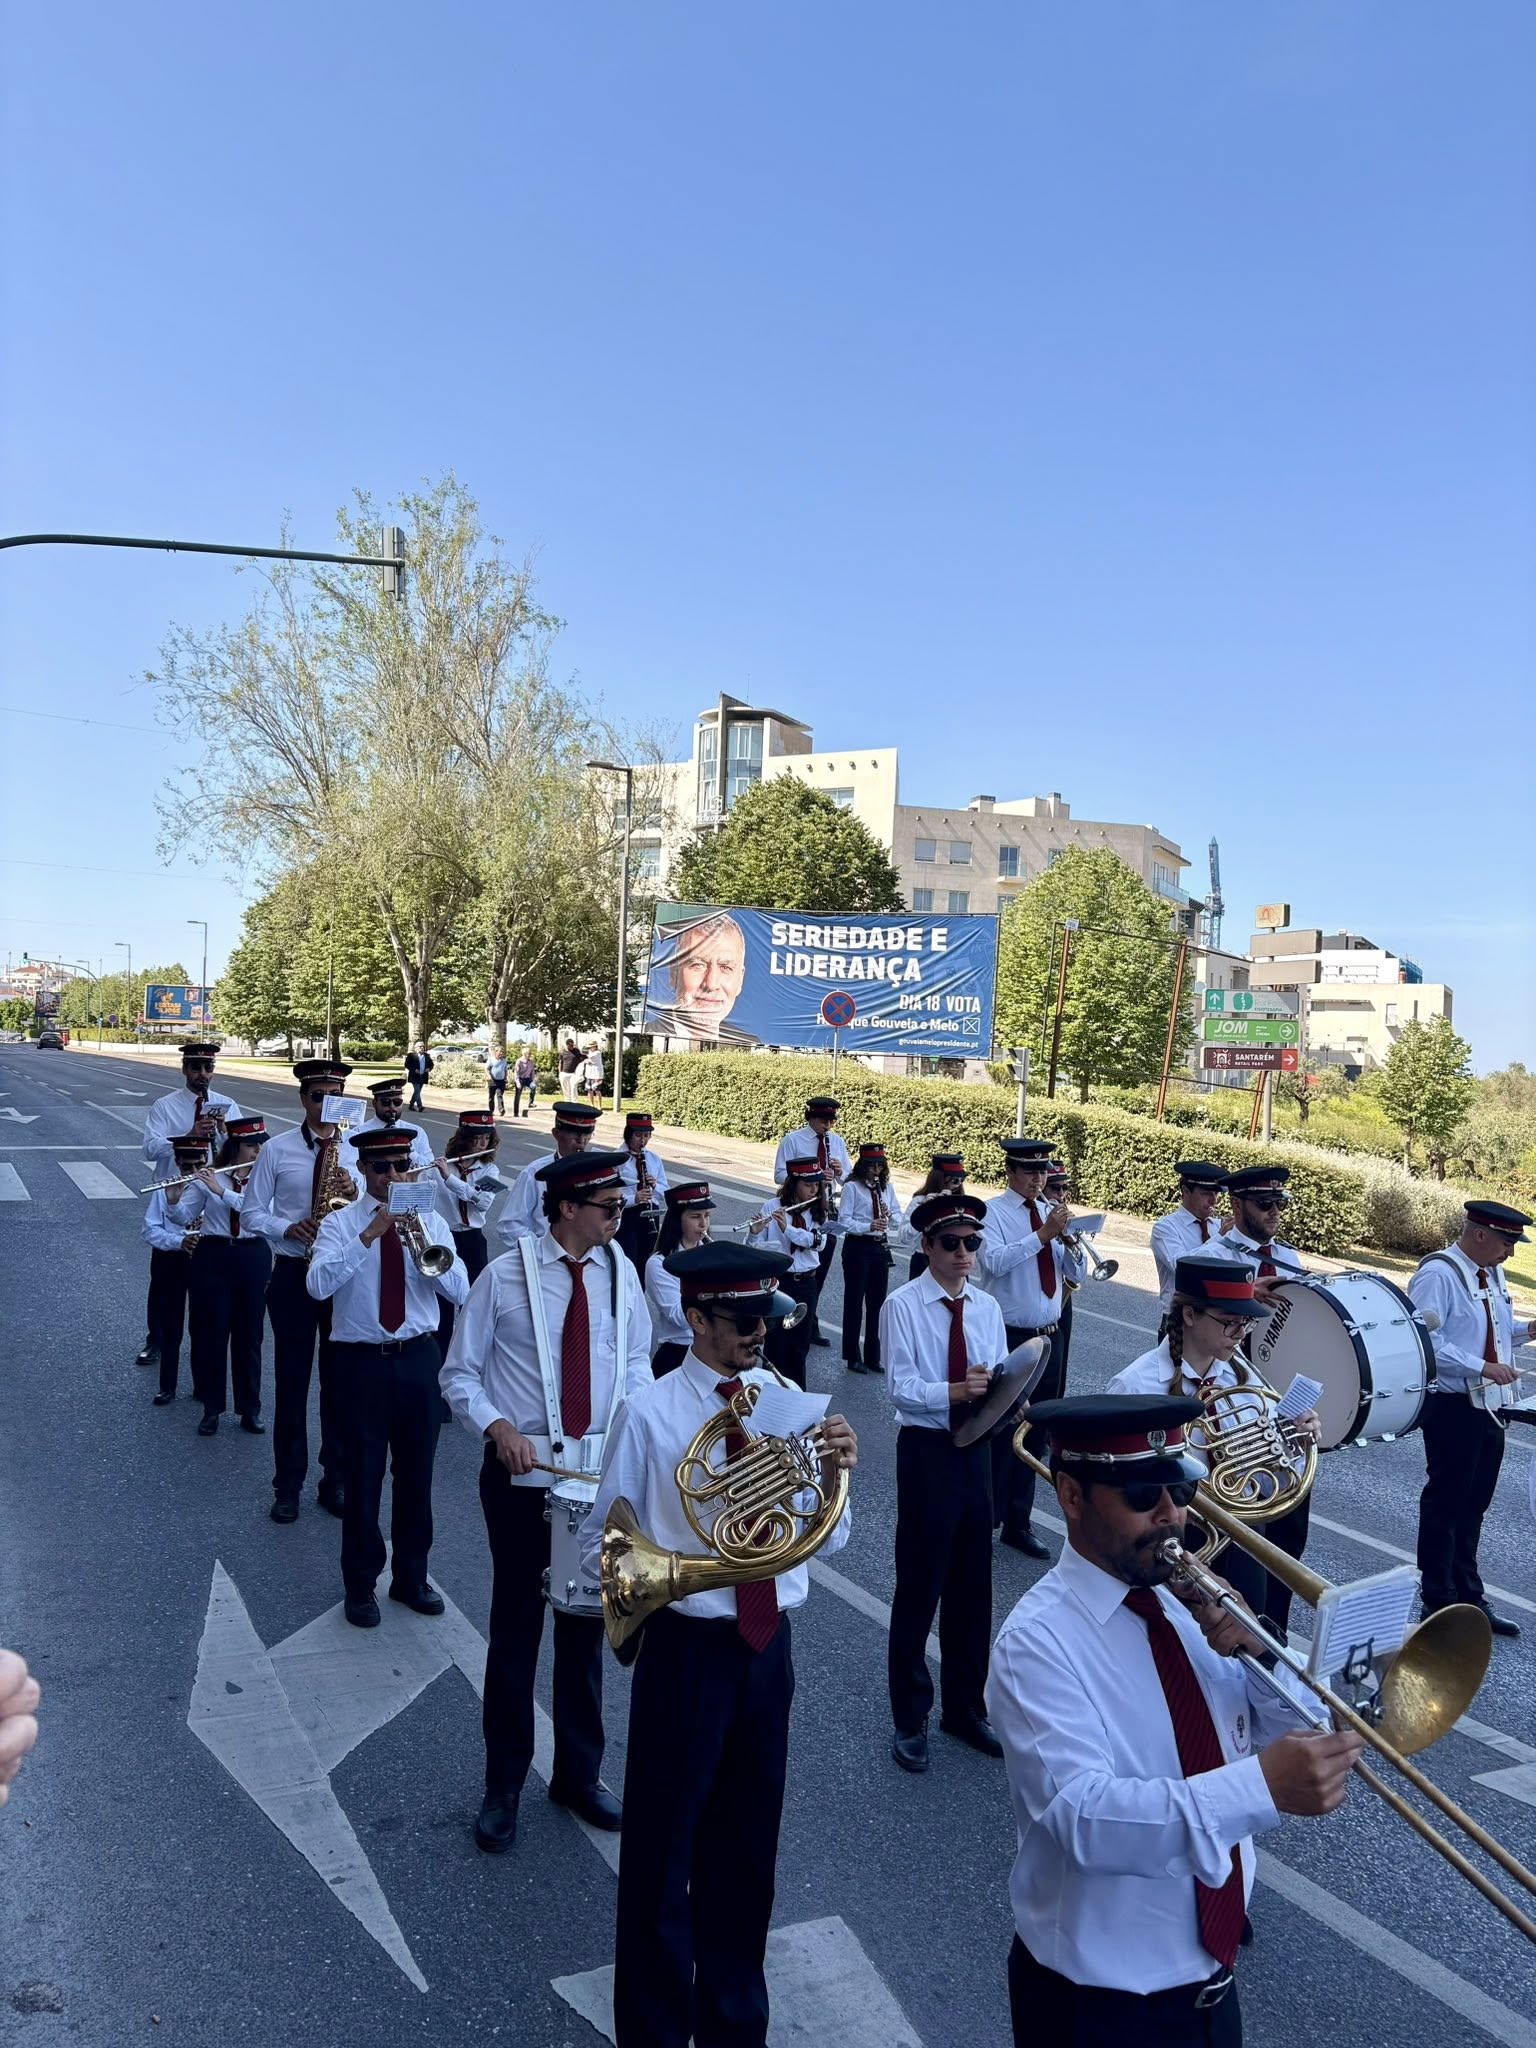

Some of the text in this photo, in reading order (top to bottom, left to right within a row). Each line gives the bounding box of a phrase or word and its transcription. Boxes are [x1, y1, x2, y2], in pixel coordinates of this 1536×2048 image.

[771, 923, 948, 951] SERIEDADE E
[770, 952, 922, 988] LIDERANÇA
[899, 995, 981, 1013] DIA 18 VOTA
[871, 1015, 918, 1030] Gouveia
[919, 1021, 928, 1030] e
[930, 1019, 959, 1032] Melo
[1214, 1021, 1248, 1033] JOM
[1235, 1052, 1274, 1061] SANTARÉM
[1263, 1299, 1294, 1348] YAMAHA
